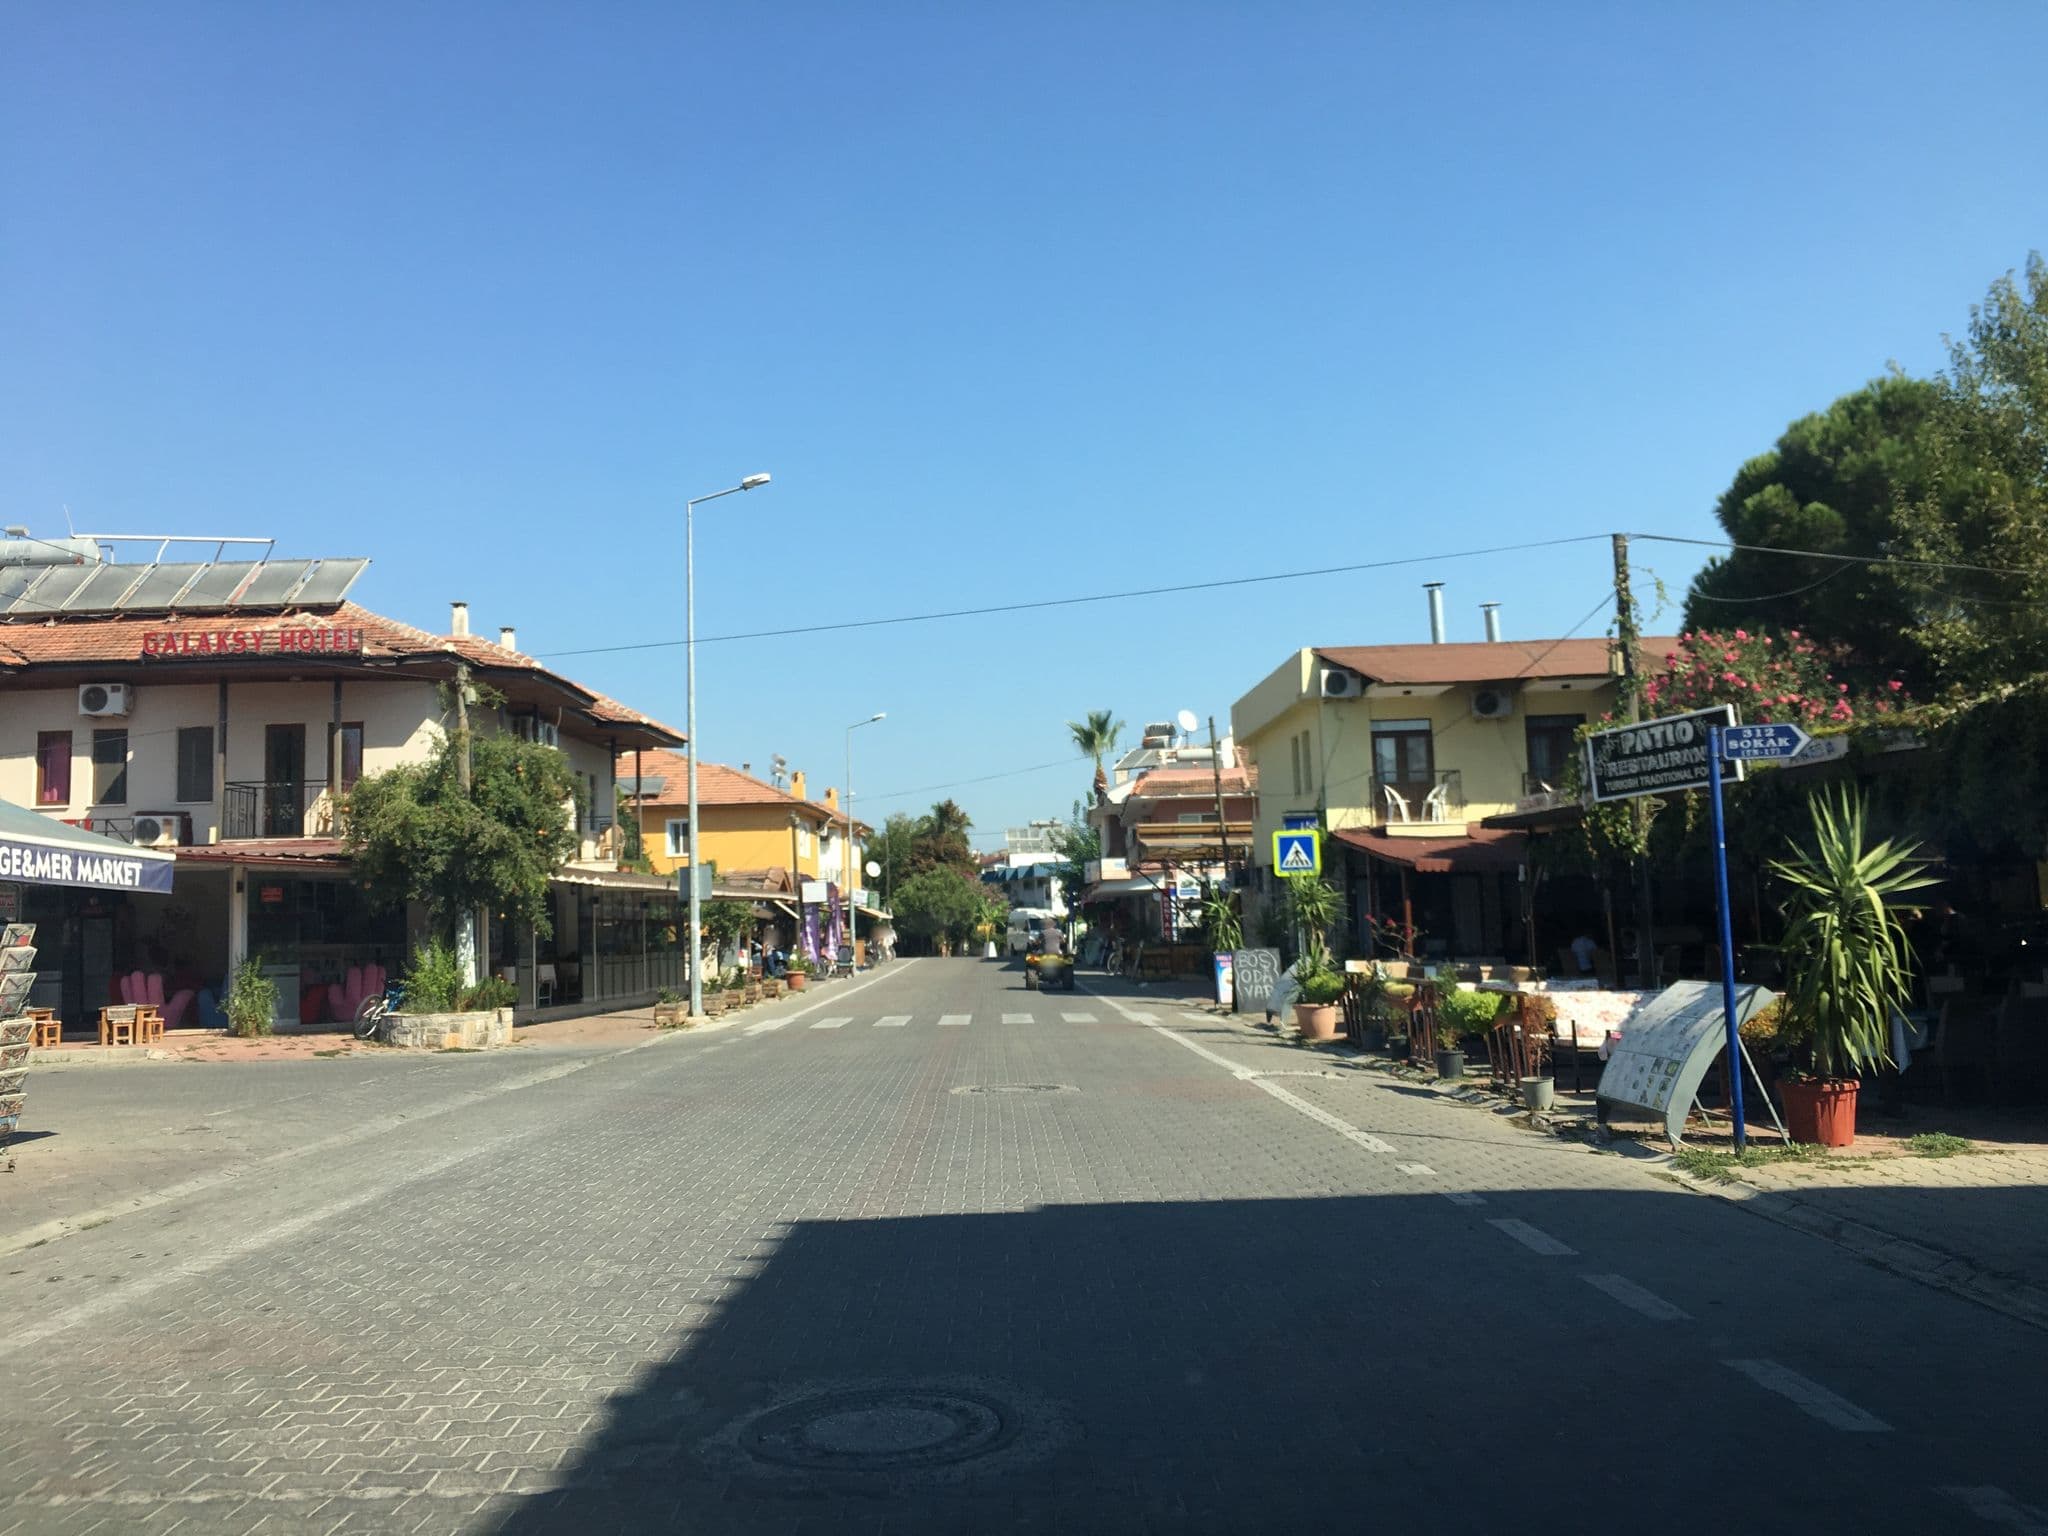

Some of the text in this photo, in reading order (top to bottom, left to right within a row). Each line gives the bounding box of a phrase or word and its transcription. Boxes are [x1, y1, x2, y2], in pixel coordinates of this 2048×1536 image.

[143, 628, 360, 655] GALAKSY HOTEL
[1620, 720, 1694, 755] PATIO
[1742, 727, 1775, 738] 312
[1728, 737, 1791, 750] SOKAK
[1607, 745, 1709, 777] RESTAURAN
[1640, 768, 1694, 787] TRADITIONAL
[76, 856, 143, 887] MARKET
[1240, 969, 1273, 984] ODA
[1244, 984, 1274, 1000] VAR
